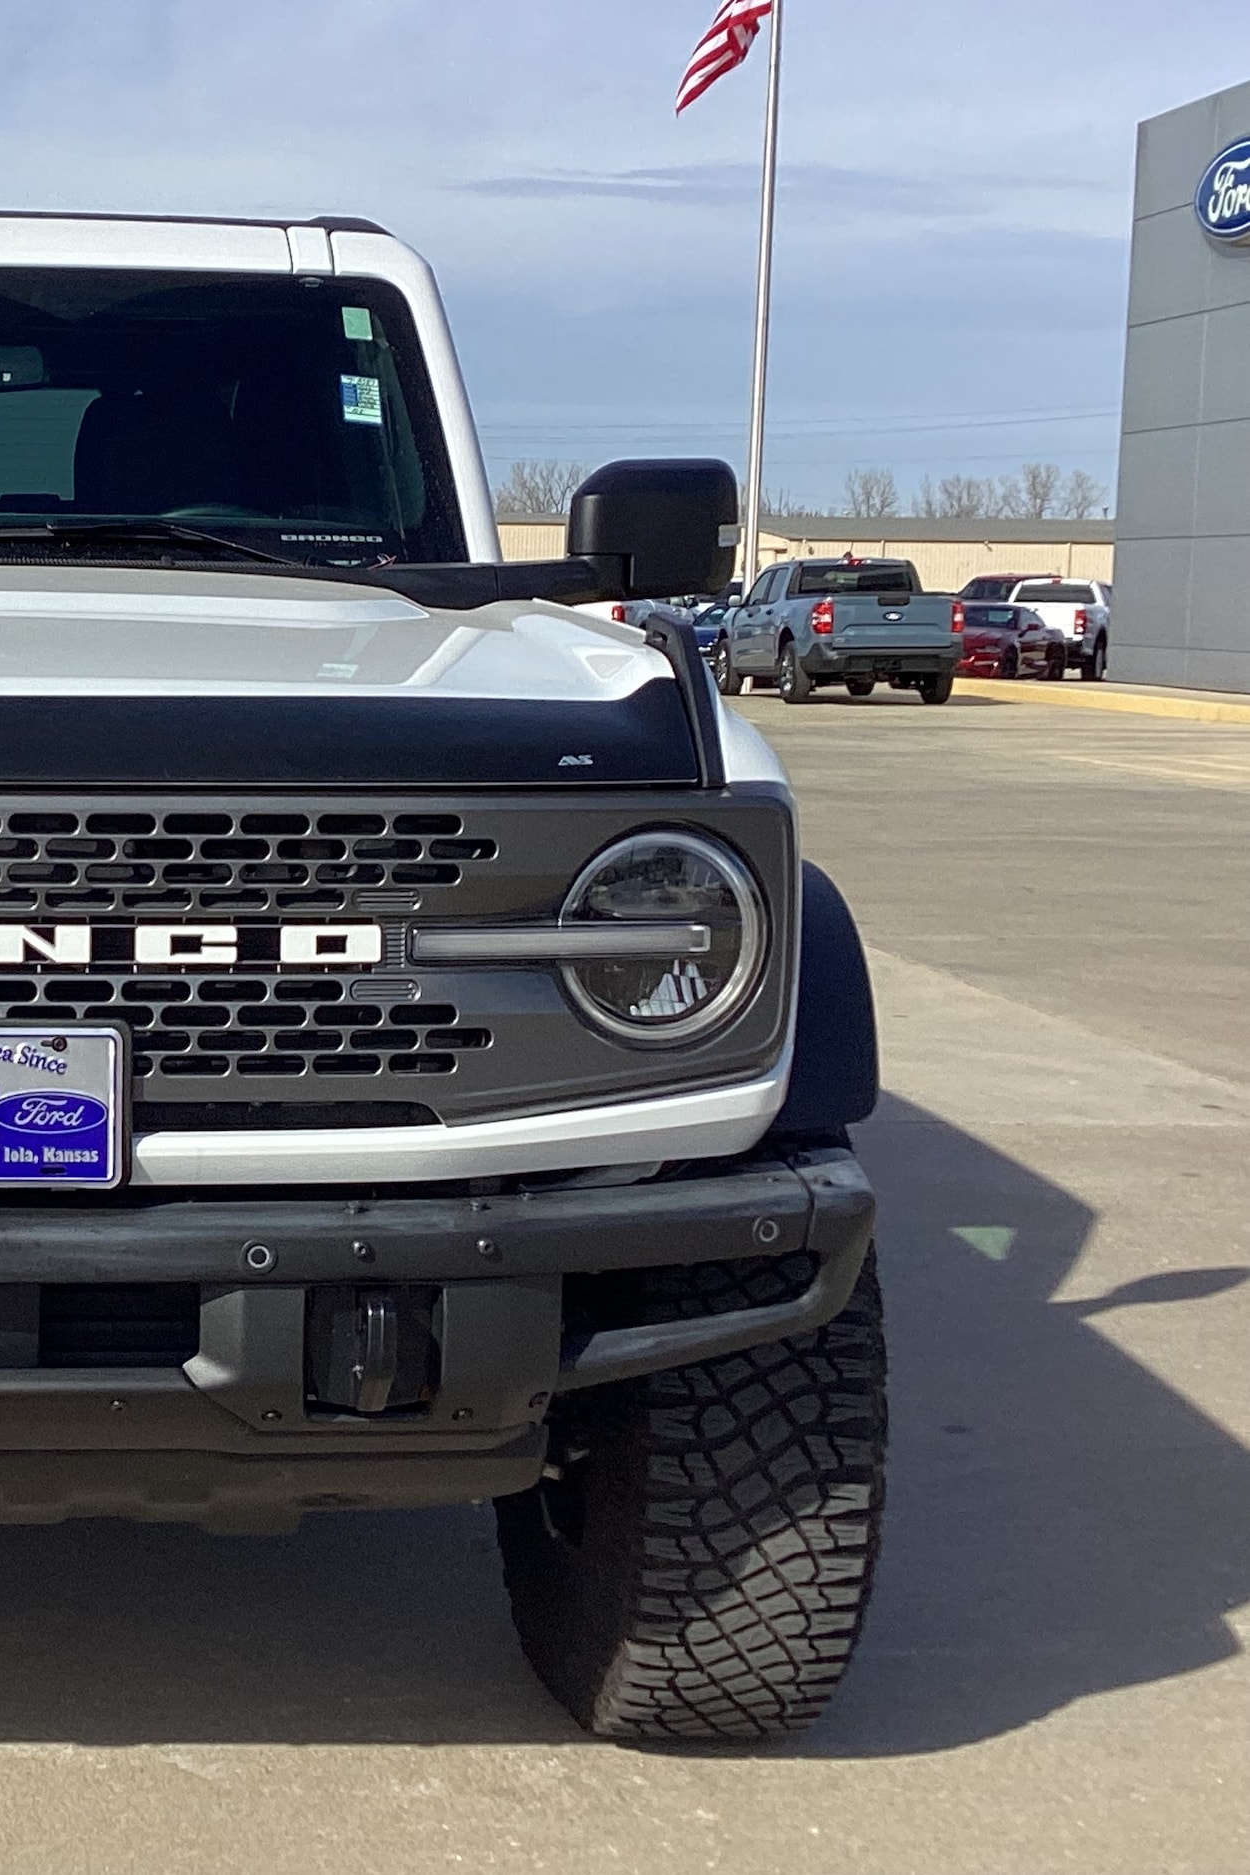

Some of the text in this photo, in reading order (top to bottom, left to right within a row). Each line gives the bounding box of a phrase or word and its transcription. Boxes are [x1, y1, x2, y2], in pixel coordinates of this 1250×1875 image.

[1208, 157, 1250, 223] For
[281, 534, 383, 543] BRONCO
[17, 1043, 68, 1075] Since
[13, 1098, 84, 1127] Ford
[3, 1146, 99, 1164] Iola, Kansas
